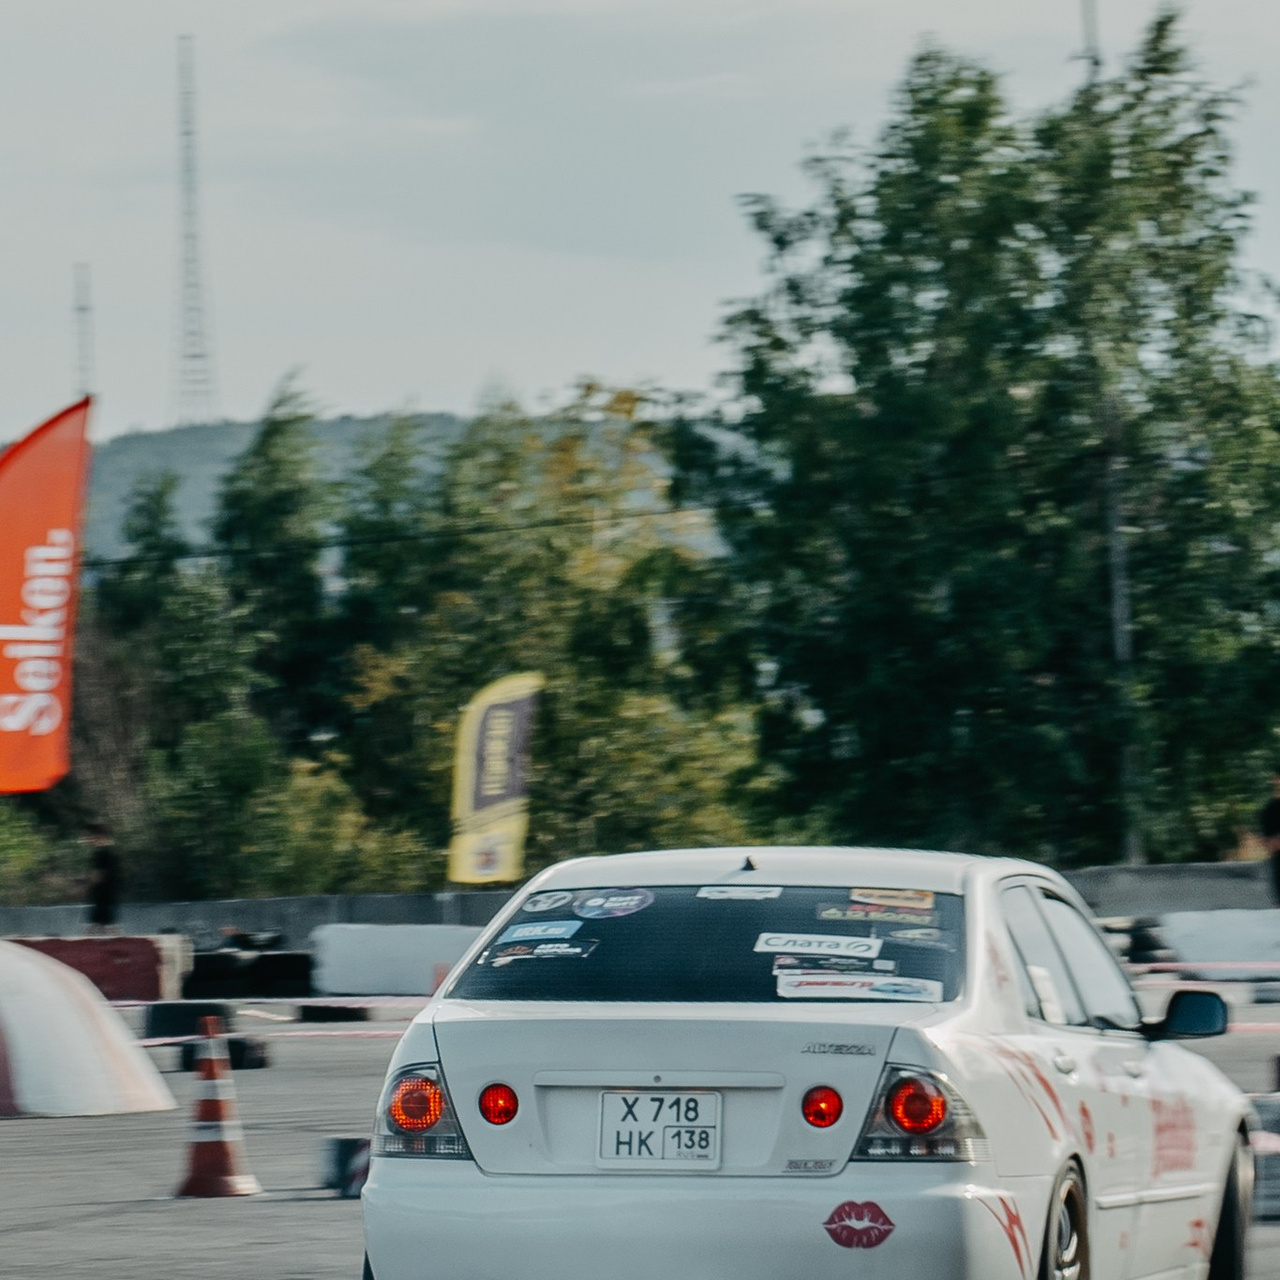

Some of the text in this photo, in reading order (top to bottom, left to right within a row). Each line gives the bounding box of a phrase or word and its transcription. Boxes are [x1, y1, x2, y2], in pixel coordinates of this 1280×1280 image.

[764, 936, 841, 950] Слата
[649, 1096, 699, 1123] 718
[615, 1129, 710, 1156] НК 138
